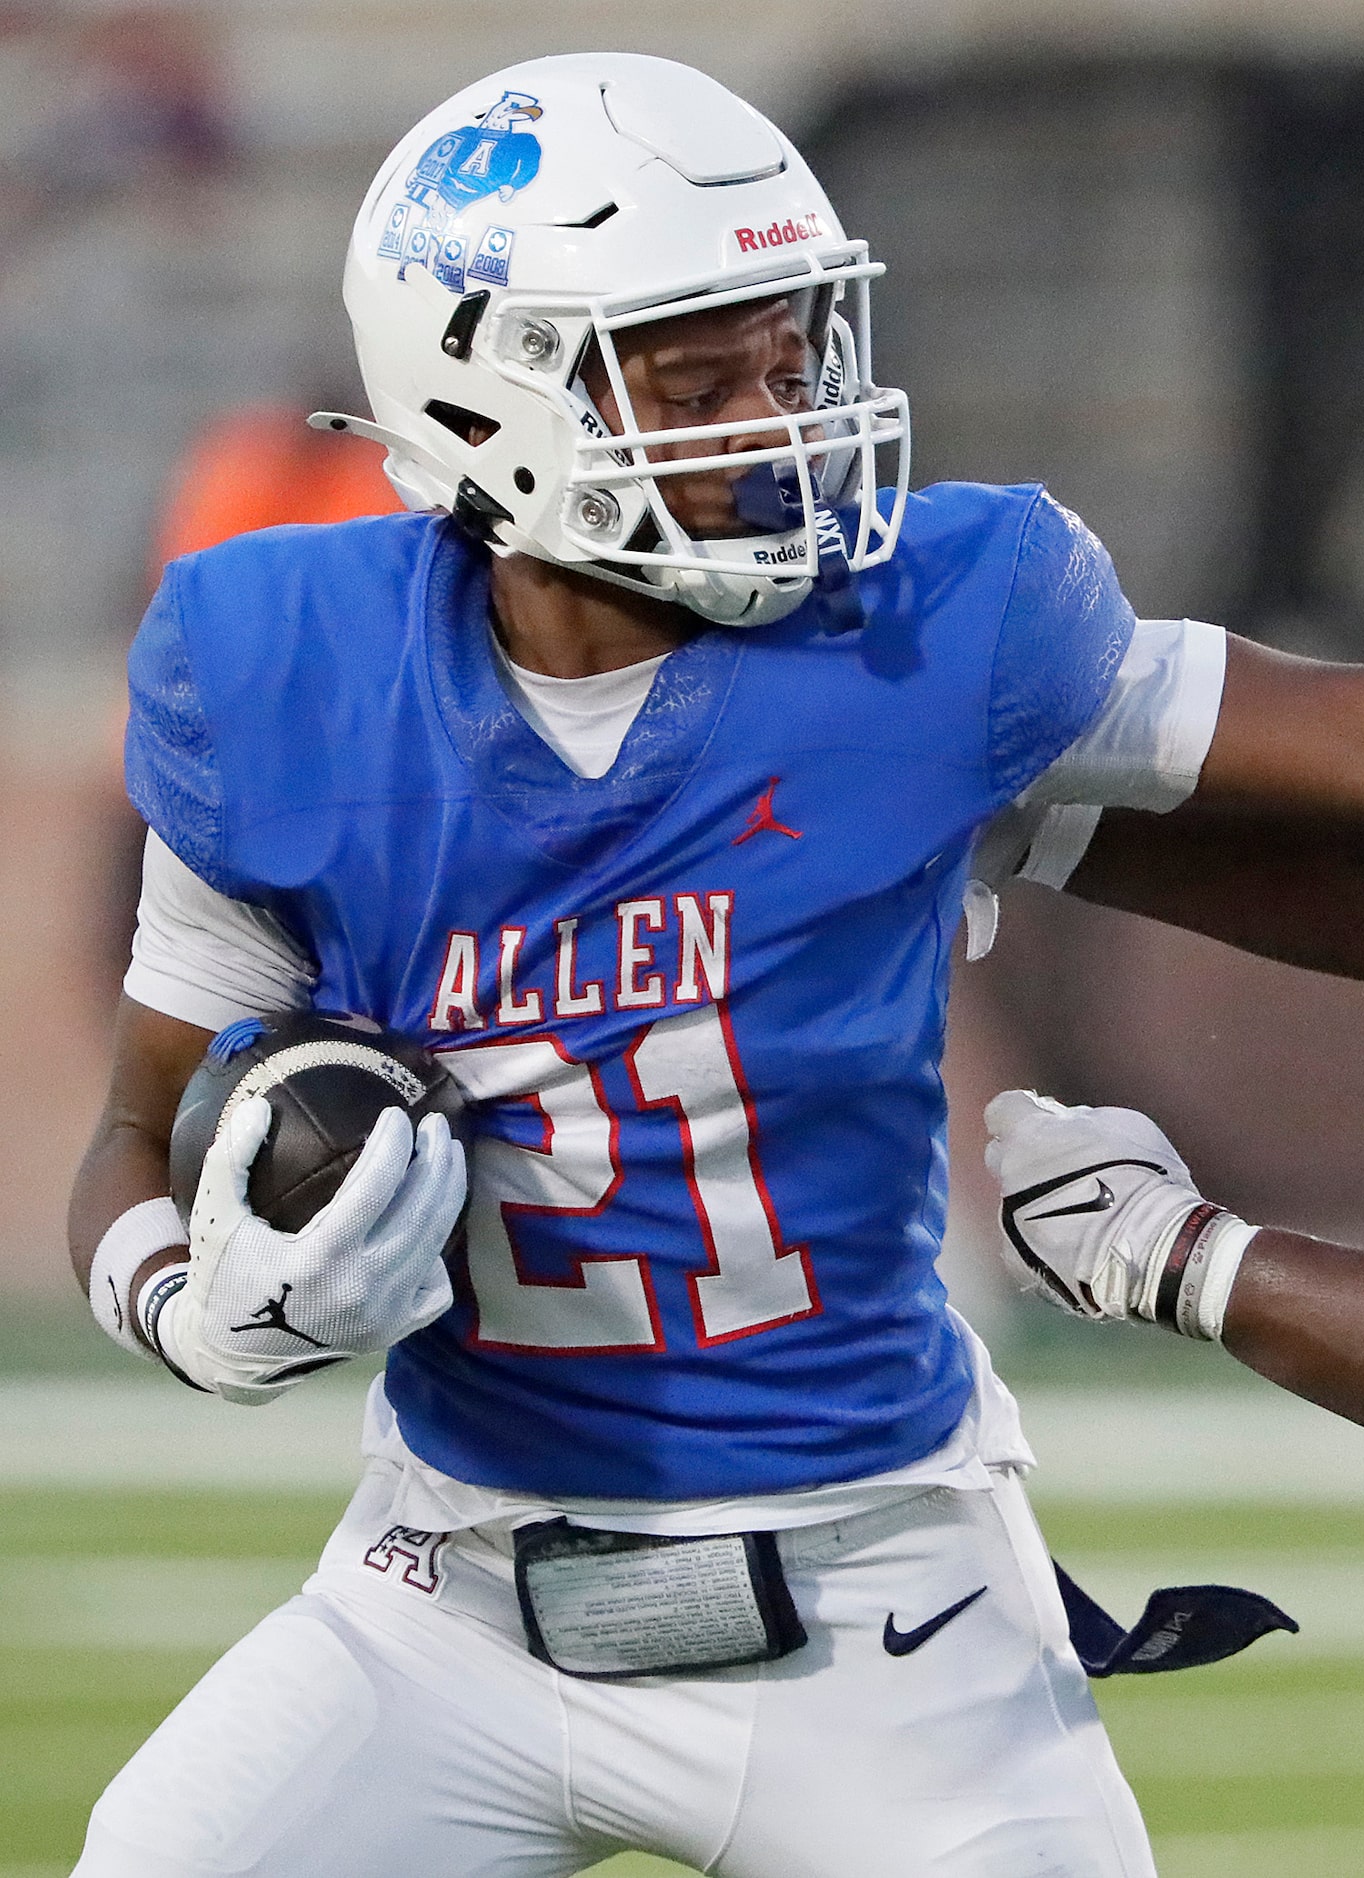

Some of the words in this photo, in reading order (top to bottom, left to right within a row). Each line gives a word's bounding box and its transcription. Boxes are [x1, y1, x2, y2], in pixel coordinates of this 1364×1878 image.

[459, 139, 496, 176] A
[734, 213, 822, 252] Riddell
[474, 253, 506, 277] 2008
[753, 539, 808, 564] Ridde
[428, 891, 735, 1031] ALLEN
[427, 1001, 824, 1354] 21
[1198, 1221, 1217, 1250] Plano
